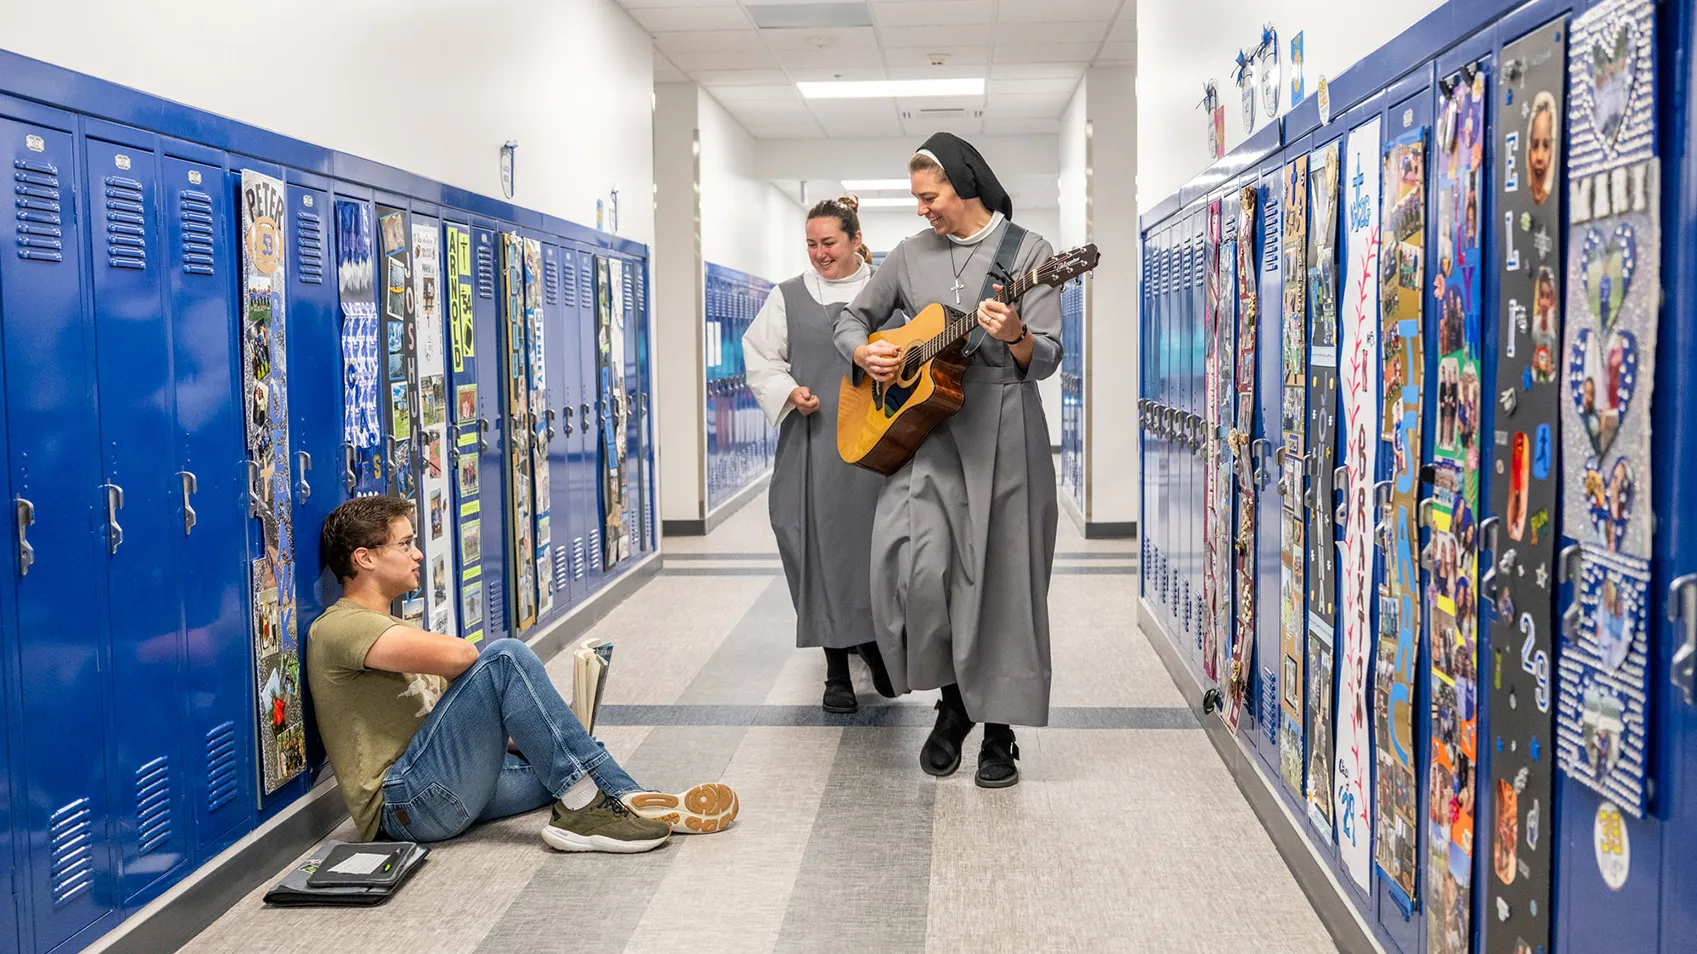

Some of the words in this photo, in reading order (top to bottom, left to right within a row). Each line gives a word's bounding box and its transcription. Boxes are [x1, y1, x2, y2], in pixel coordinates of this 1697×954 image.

[246, 182, 284, 231] PETER
[262, 233, 273, 255] 53
[449, 232, 461, 368] ARNOLD
[1505, 132, 1520, 357] ELI
[405, 252, 418, 451] JOSHUA
[1316, 372, 1327, 614] JOHANNA
[1356, 423, 1367, 728] BRAXTON
[1388, 320, 1419, 767] ISAAC
[1520, 611, 1551, 713] 29
